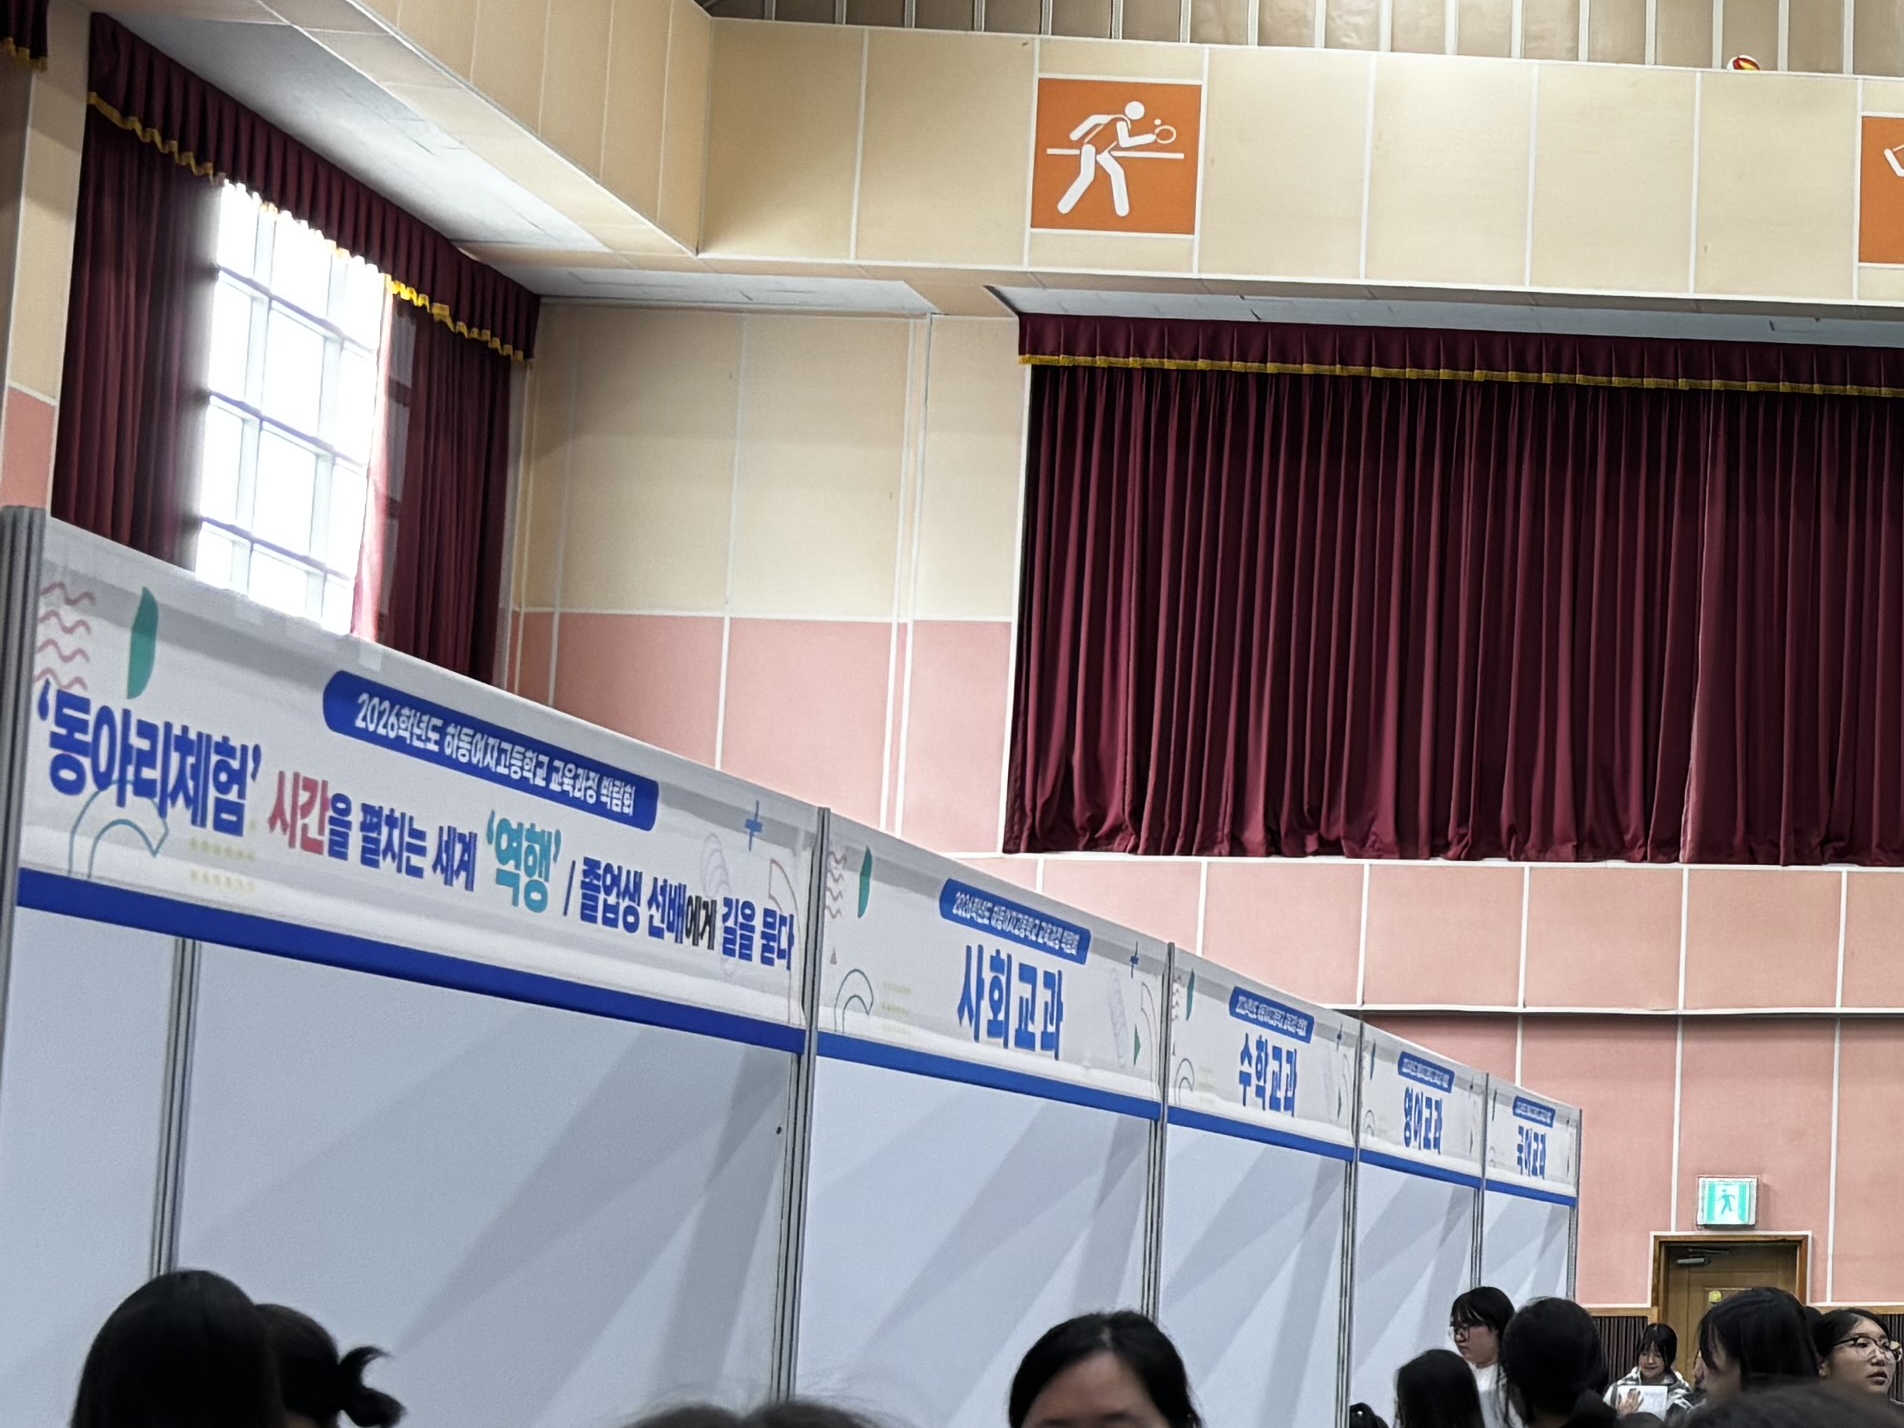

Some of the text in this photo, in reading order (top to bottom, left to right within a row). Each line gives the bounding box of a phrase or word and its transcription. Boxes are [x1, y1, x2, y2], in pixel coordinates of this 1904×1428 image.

[355, 692, 636, 816] 2026학년도 하동여자고등학교 교육과정 박람회
[267, 769, 354, 861] 시간을
[359, 802, 427, 878] 펼치는
[432, 826, 477, 892] 세계
[579, 857, 642, 936] 졸업생
[647, 880, 716, 952] 선배에게
[720, 896, 757, 962] 길을
[760, 911, 796, 971] 묻다
[957, 944, 1063, 1061] 사회교과
[1238, 1032, 1297, 1117] 수학교과
